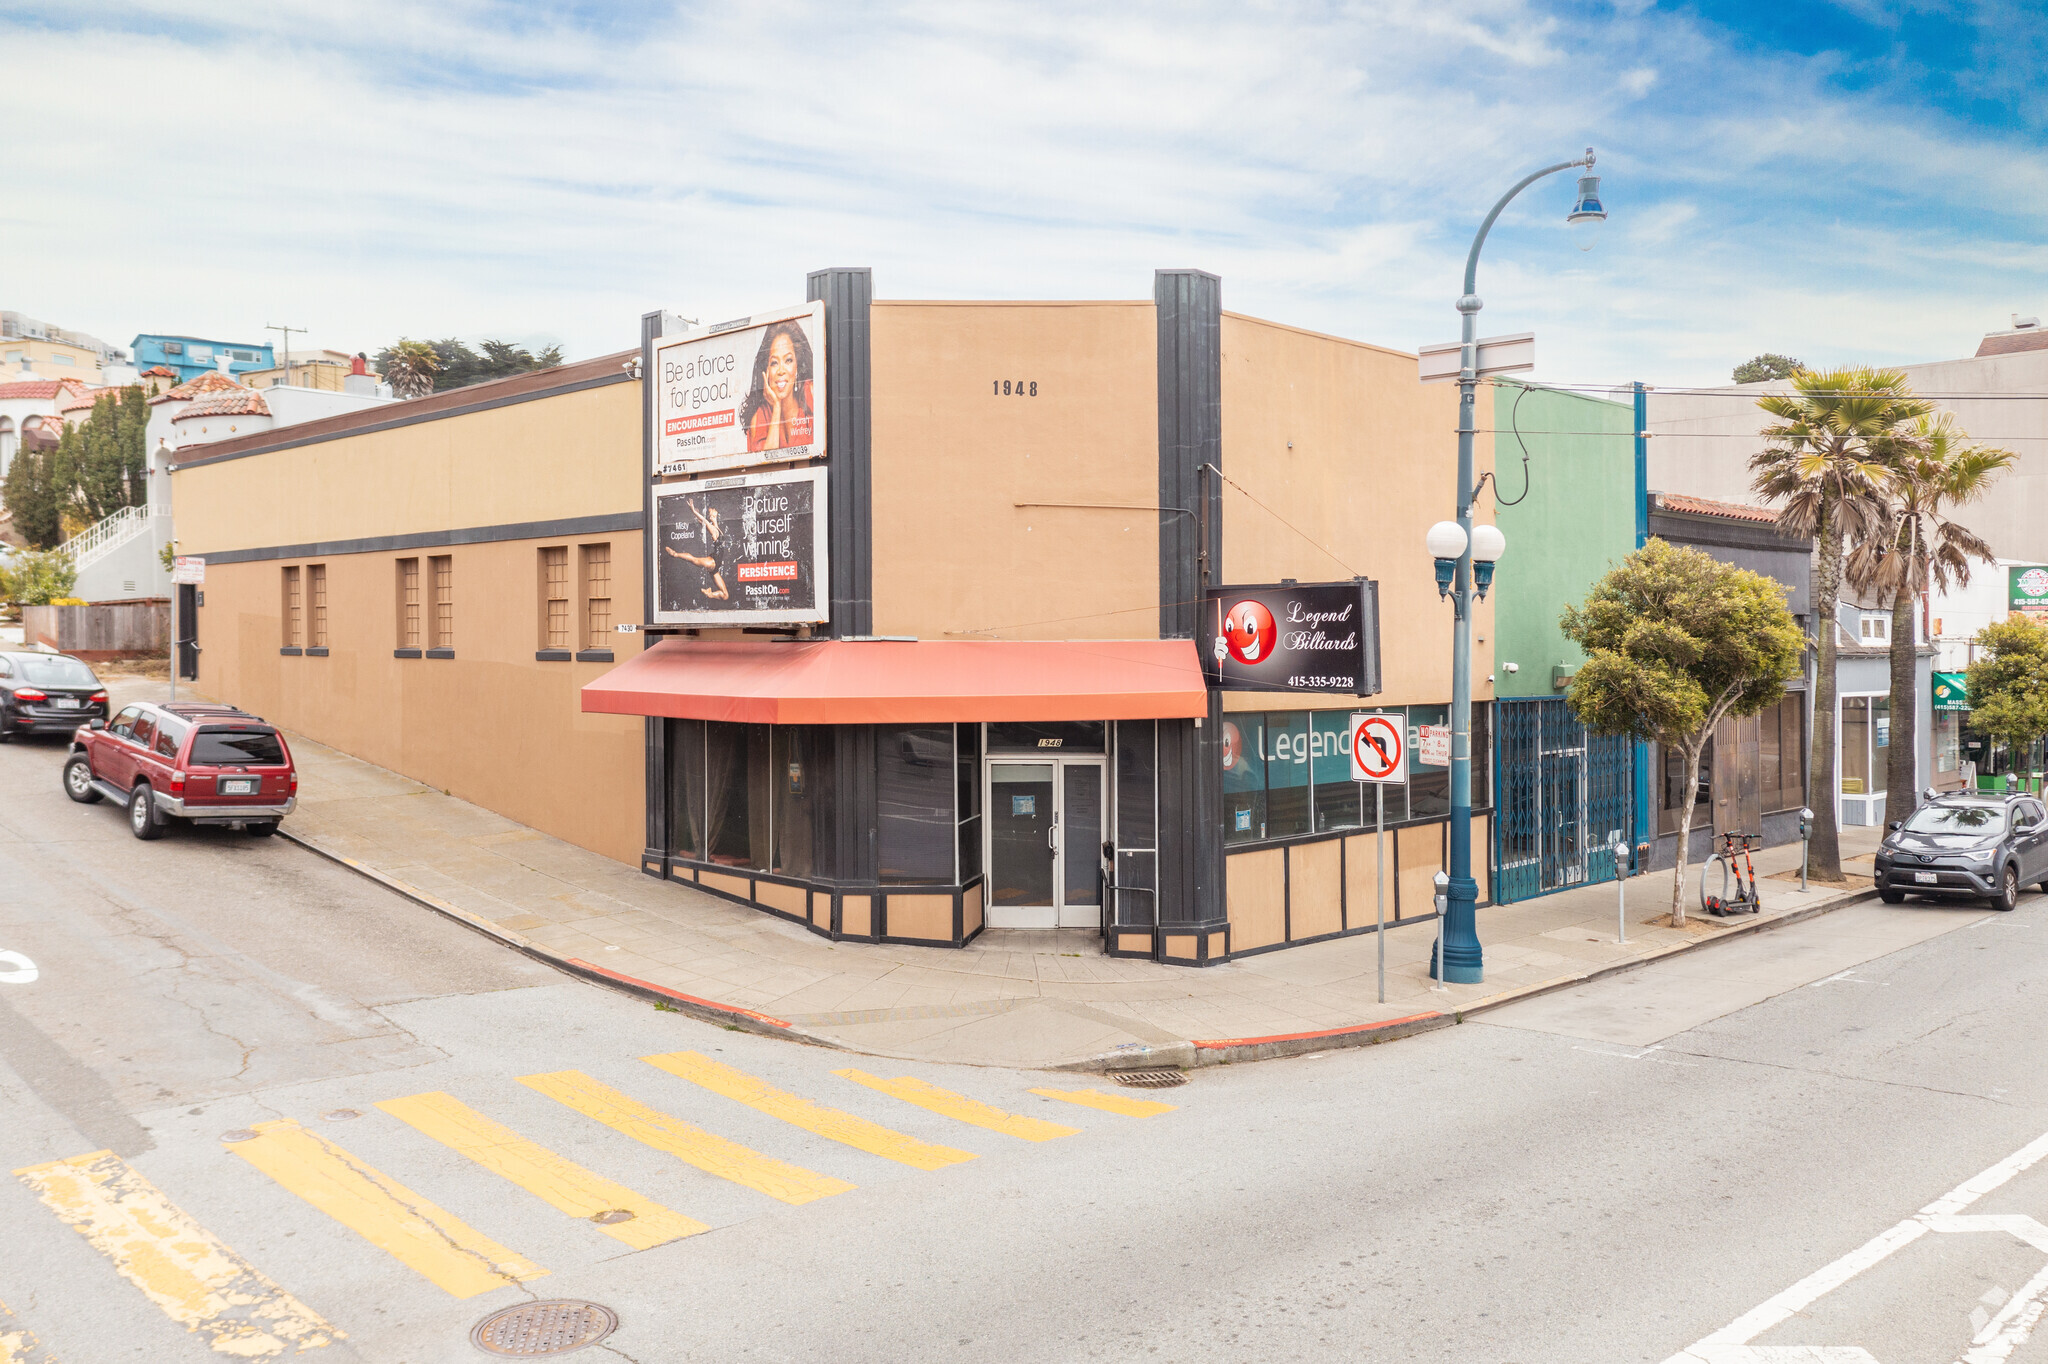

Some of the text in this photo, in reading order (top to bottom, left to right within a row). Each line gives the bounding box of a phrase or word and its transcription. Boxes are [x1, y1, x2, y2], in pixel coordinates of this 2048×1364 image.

[665, 354, 735, 384] Be a force
[670, 378, 732, 410] for good.
[993, 380, 1038, 397] 1948
[667, 412, 734, 433] ENCOURAGEMENT
[790, 426, 812, 437] Winfrey
[663, 463, 686, 473] #7461
[745, 496, 788, 514] Picture
[675, 522, 690, 532] Misty
[742, 513, 792, 539] yourself
[670, 531, 695, 541] Copeland
[739, 565, 796, 578] PERSISTENCE
[745, 584, 790, 596] PassItOn.com
[1286, 601, 1353, 629] Legend
[1283, 631, 1358, 650] Billiards
[1288, 676, 1354, 687] 415-335-9228
[1421, 726, 1449, 739] NO PARKING
[1039, 739, 1062, 747] 1948
